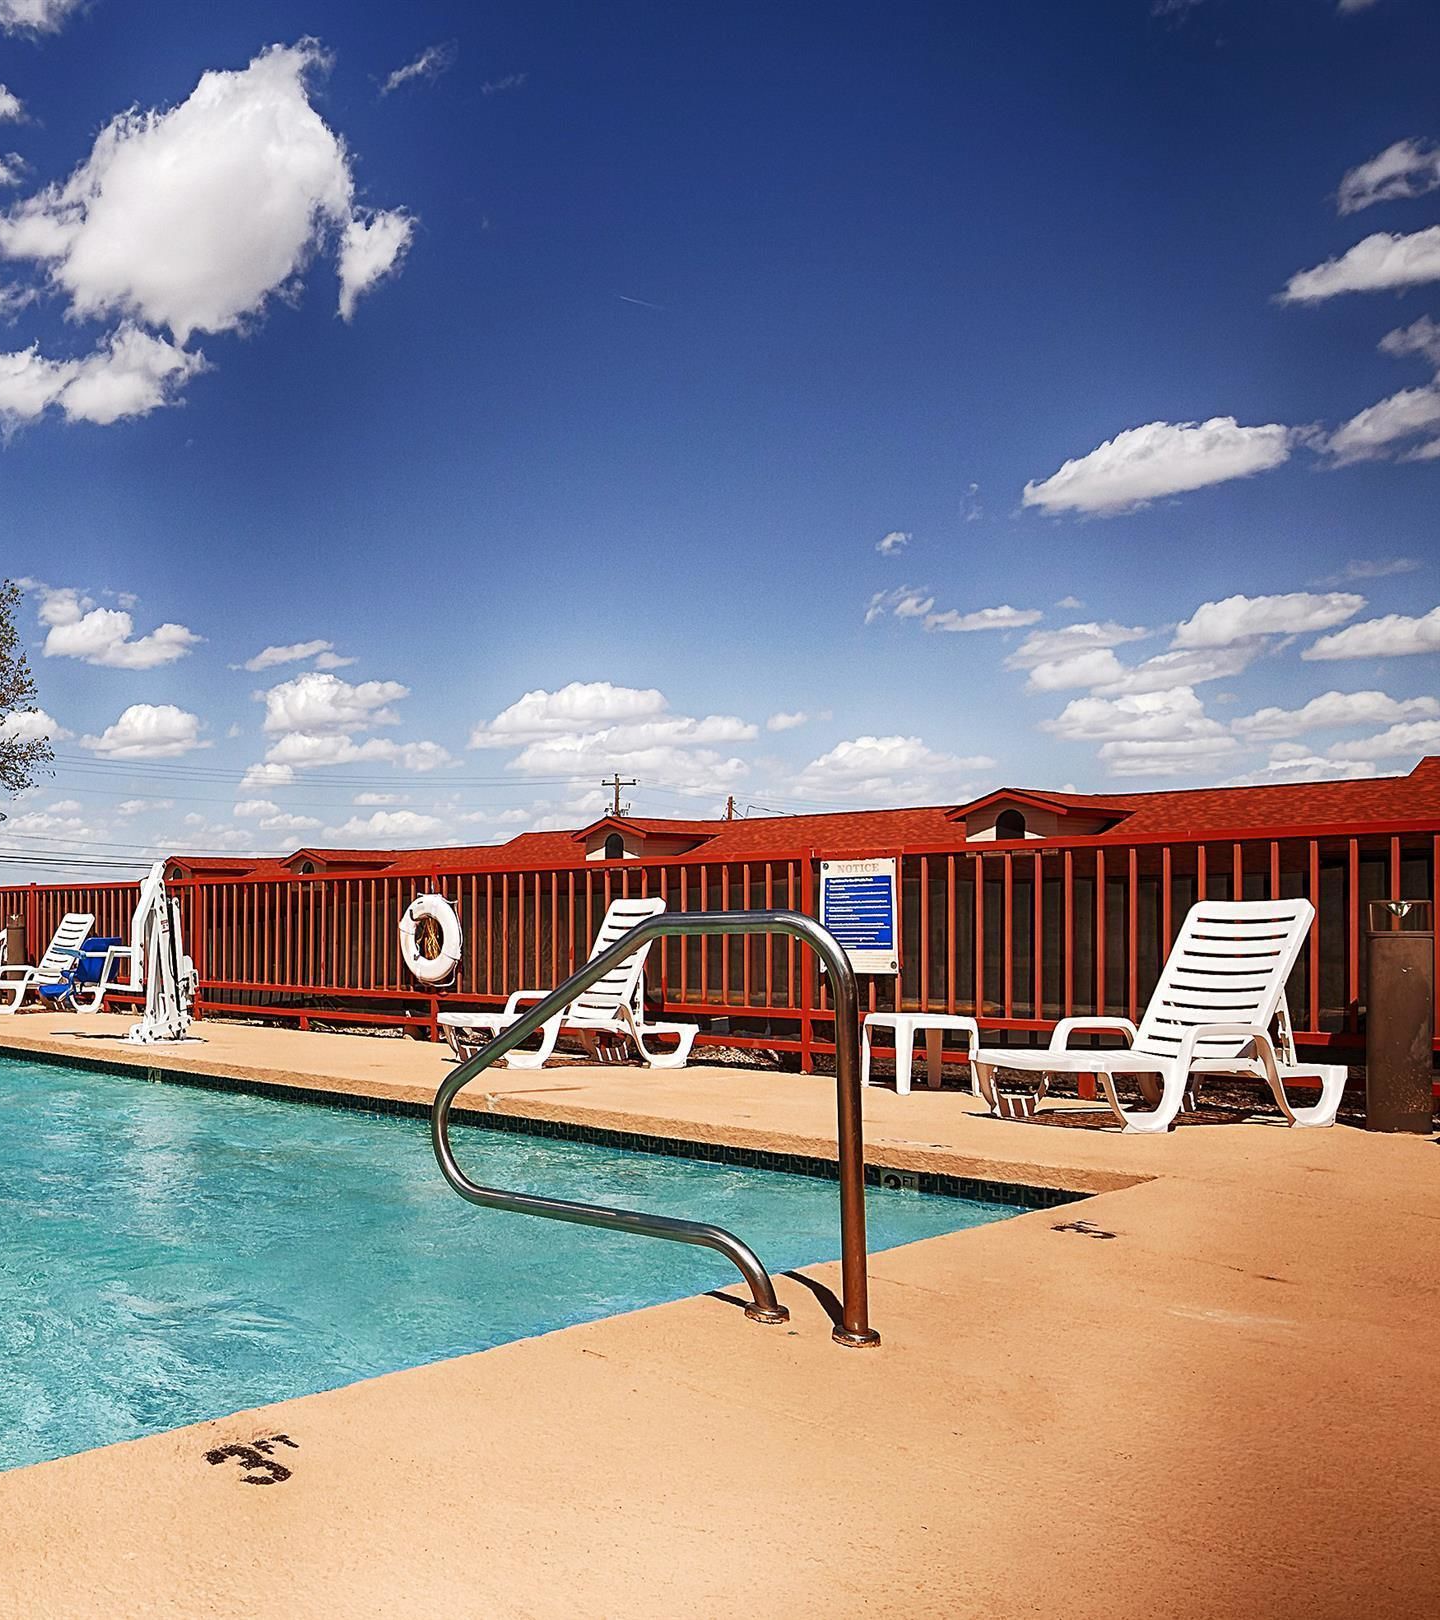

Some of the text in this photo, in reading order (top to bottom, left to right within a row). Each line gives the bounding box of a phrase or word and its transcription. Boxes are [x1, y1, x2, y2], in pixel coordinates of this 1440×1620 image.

[837, 863, 879, 873] NOTICE
[903, 1176, 915, 1187] FT
[201, 1444, 293, 1485] 3
